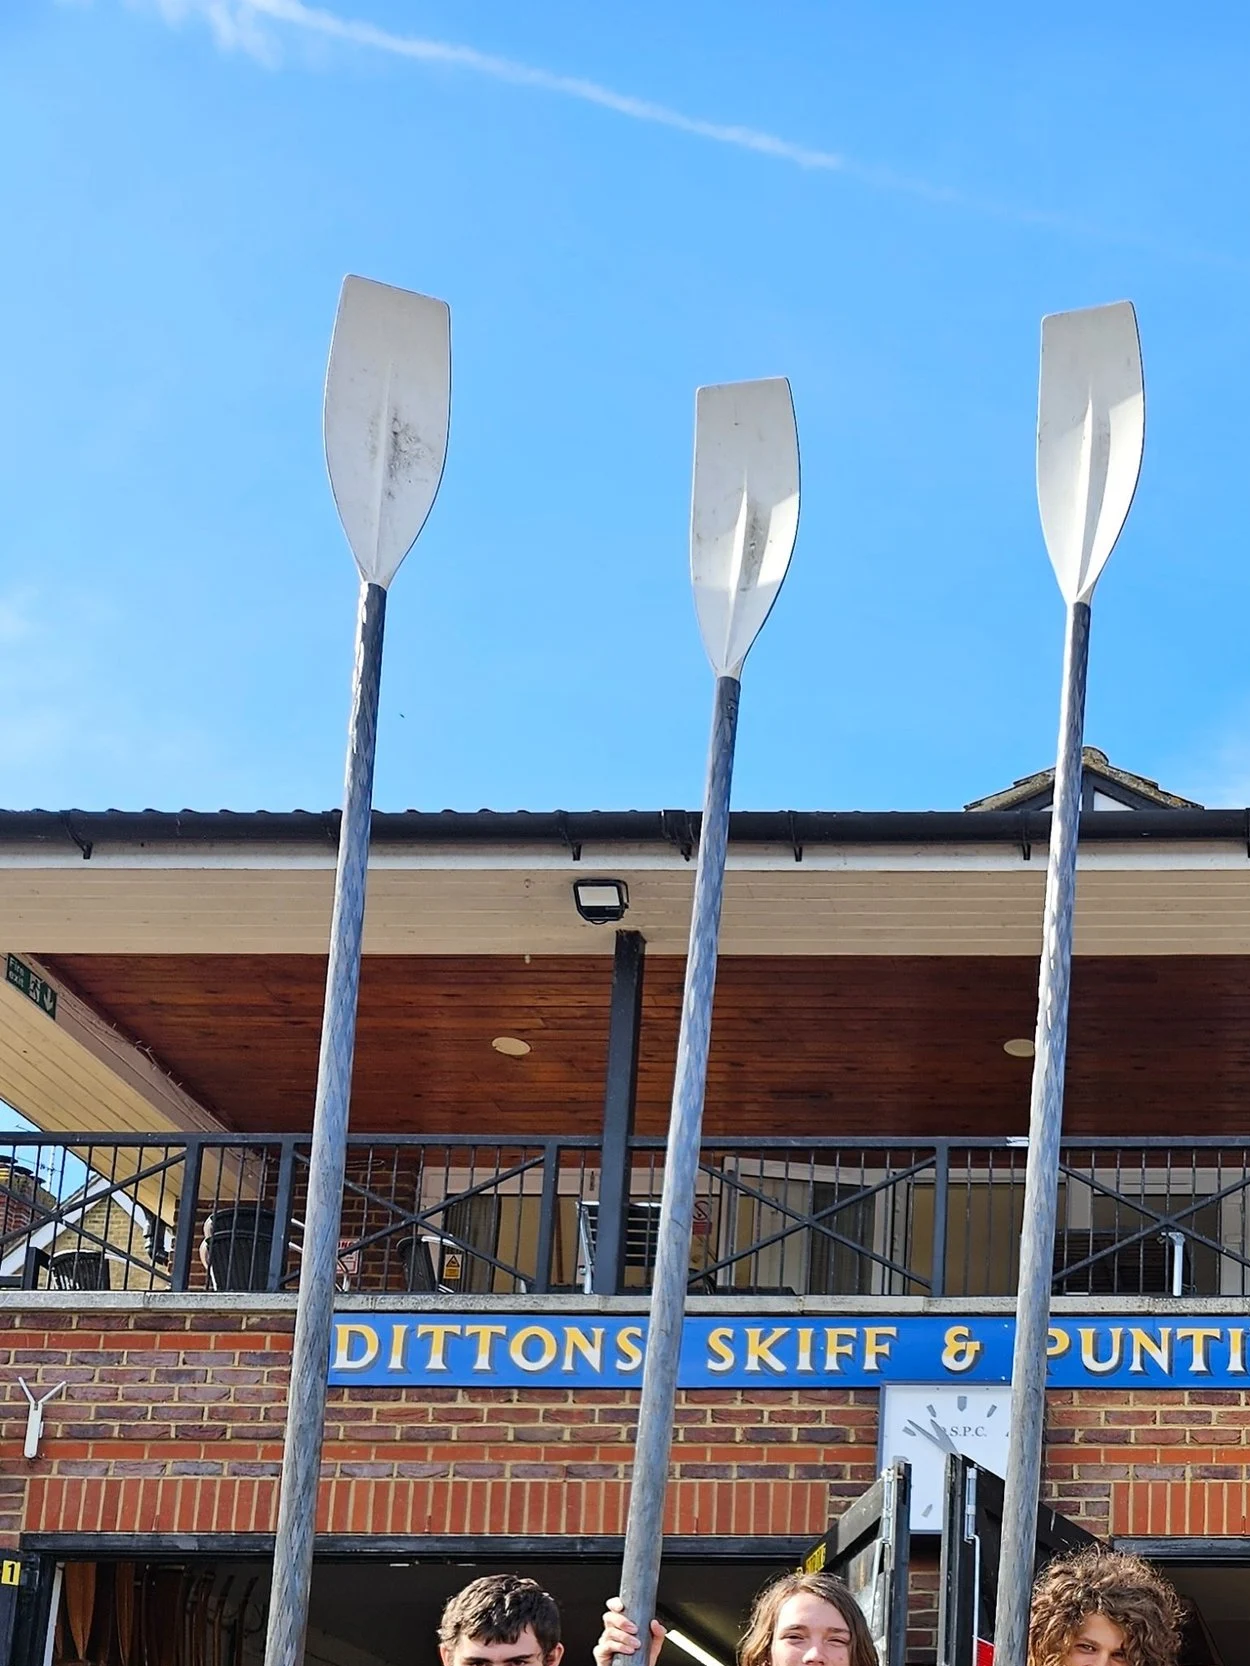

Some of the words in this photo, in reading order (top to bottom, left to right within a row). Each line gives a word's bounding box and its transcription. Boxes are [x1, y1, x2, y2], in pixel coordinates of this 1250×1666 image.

[331, 1323, 643, 1373] DITTONS
[706, 1325, 898, 1374] SKIFF
[940, 1325, 981, 1373] &
[943, 1426, 987, 1437] .S.P.C.
[8, 1563, 15, 1583] 1
